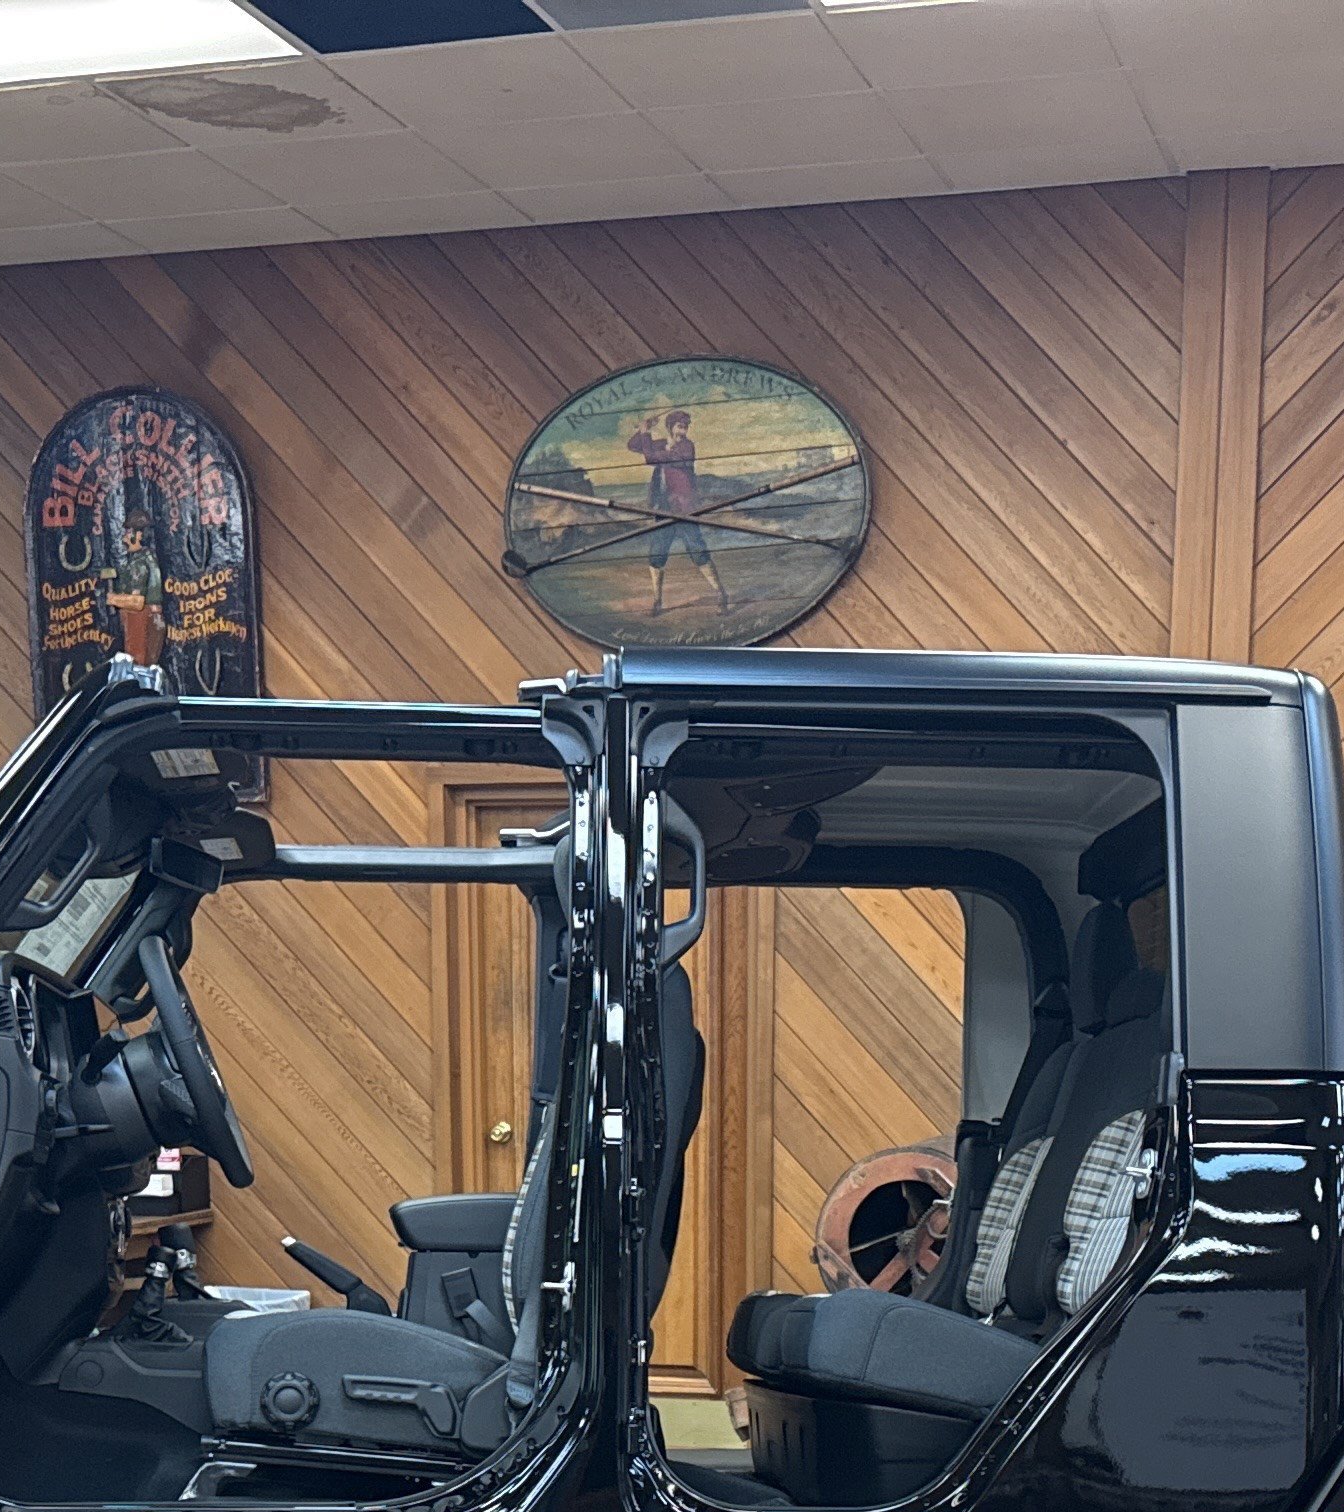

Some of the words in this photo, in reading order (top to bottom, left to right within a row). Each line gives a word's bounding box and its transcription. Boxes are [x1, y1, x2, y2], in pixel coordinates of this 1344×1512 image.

[564, 380, 633, 431] ROYAL
[42, 438, 102, 528] BILL
[108, 404, 229, 526] COLLIER
[42, 577, 98, 602] QUALITY
[164, 577, 199, 597] GOOD
[179, 586, 228, 613] IRONS
[48, 612, 94, 636] SHOES
[183, 607, 216, 628] FOR
